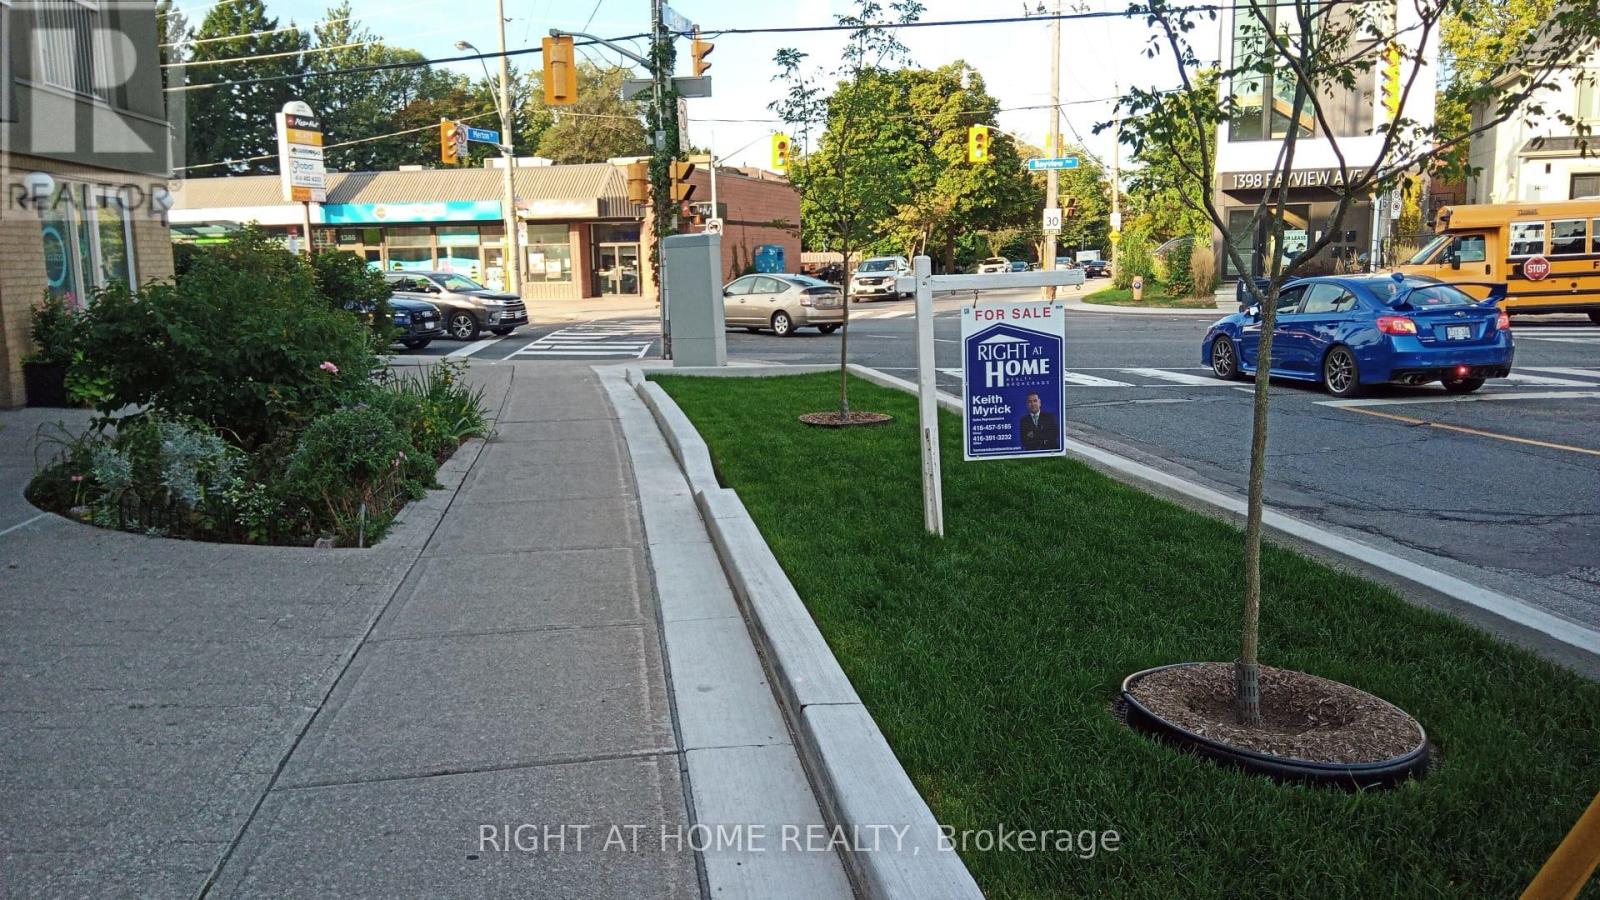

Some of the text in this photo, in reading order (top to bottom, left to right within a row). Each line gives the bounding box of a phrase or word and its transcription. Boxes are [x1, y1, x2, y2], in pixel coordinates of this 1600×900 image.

[1034, 160, 1063, 169] Bayview
[1232, 173, 1263, 188] 1398
[1046, 217, 1059, 227] 30
[1528, 264, 1547, 274] STOP
[975, 306, 1051, 321] FOR SALE
[977, 343, 1043, 361] RIGHT AT
[985, 358, 1050, 388] HOME
[972, 394, 1003, 405] Keith
[972, 405, 1011, 416] Myrick
